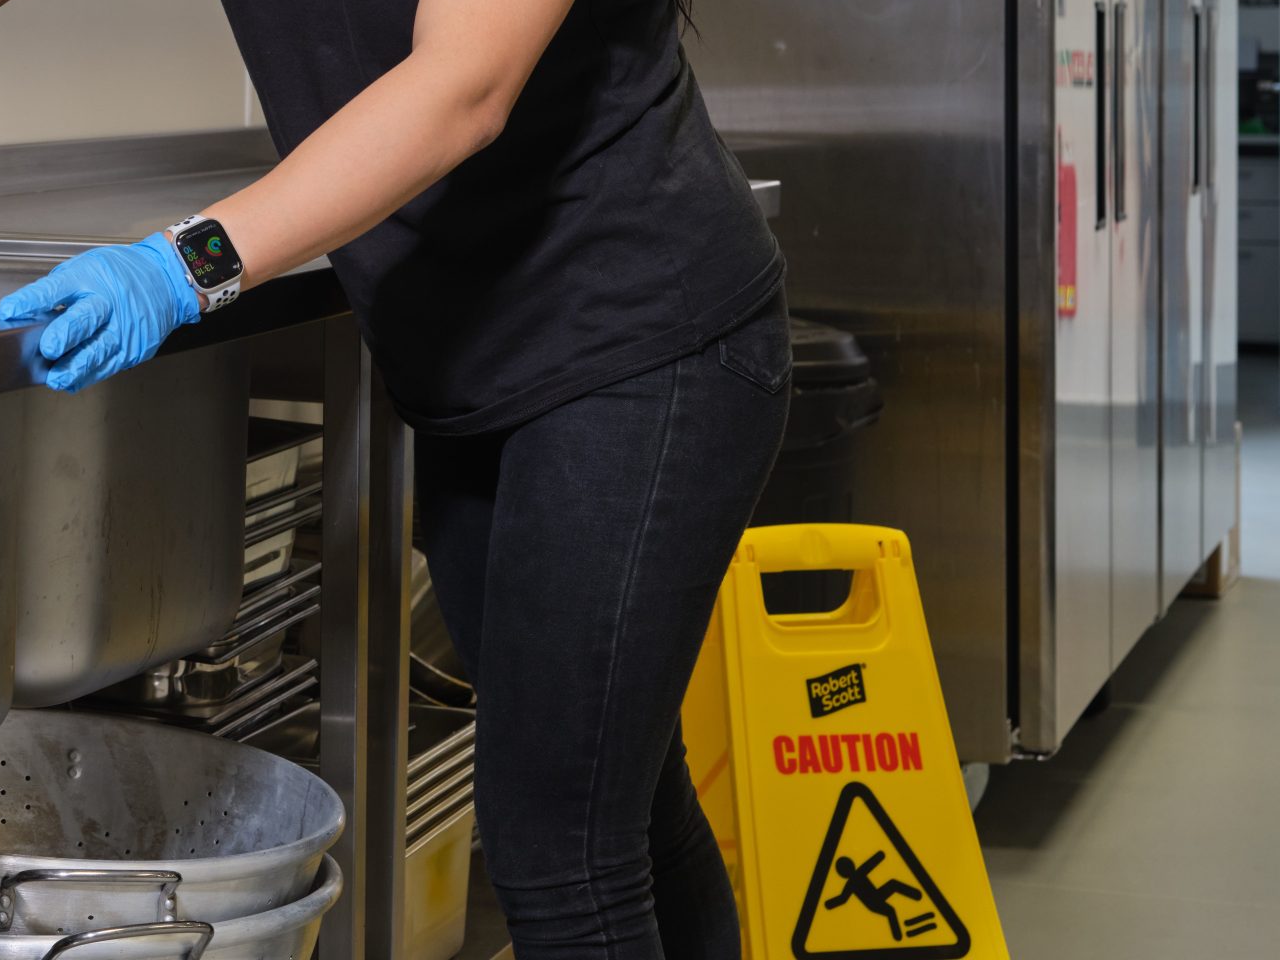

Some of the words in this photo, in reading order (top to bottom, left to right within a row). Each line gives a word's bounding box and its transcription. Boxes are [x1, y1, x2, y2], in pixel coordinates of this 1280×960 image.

[810, 669, 860, 699] Robert
[821, 686, 862, 711] Scott
[772, 731, 924, 776] CAUTION
